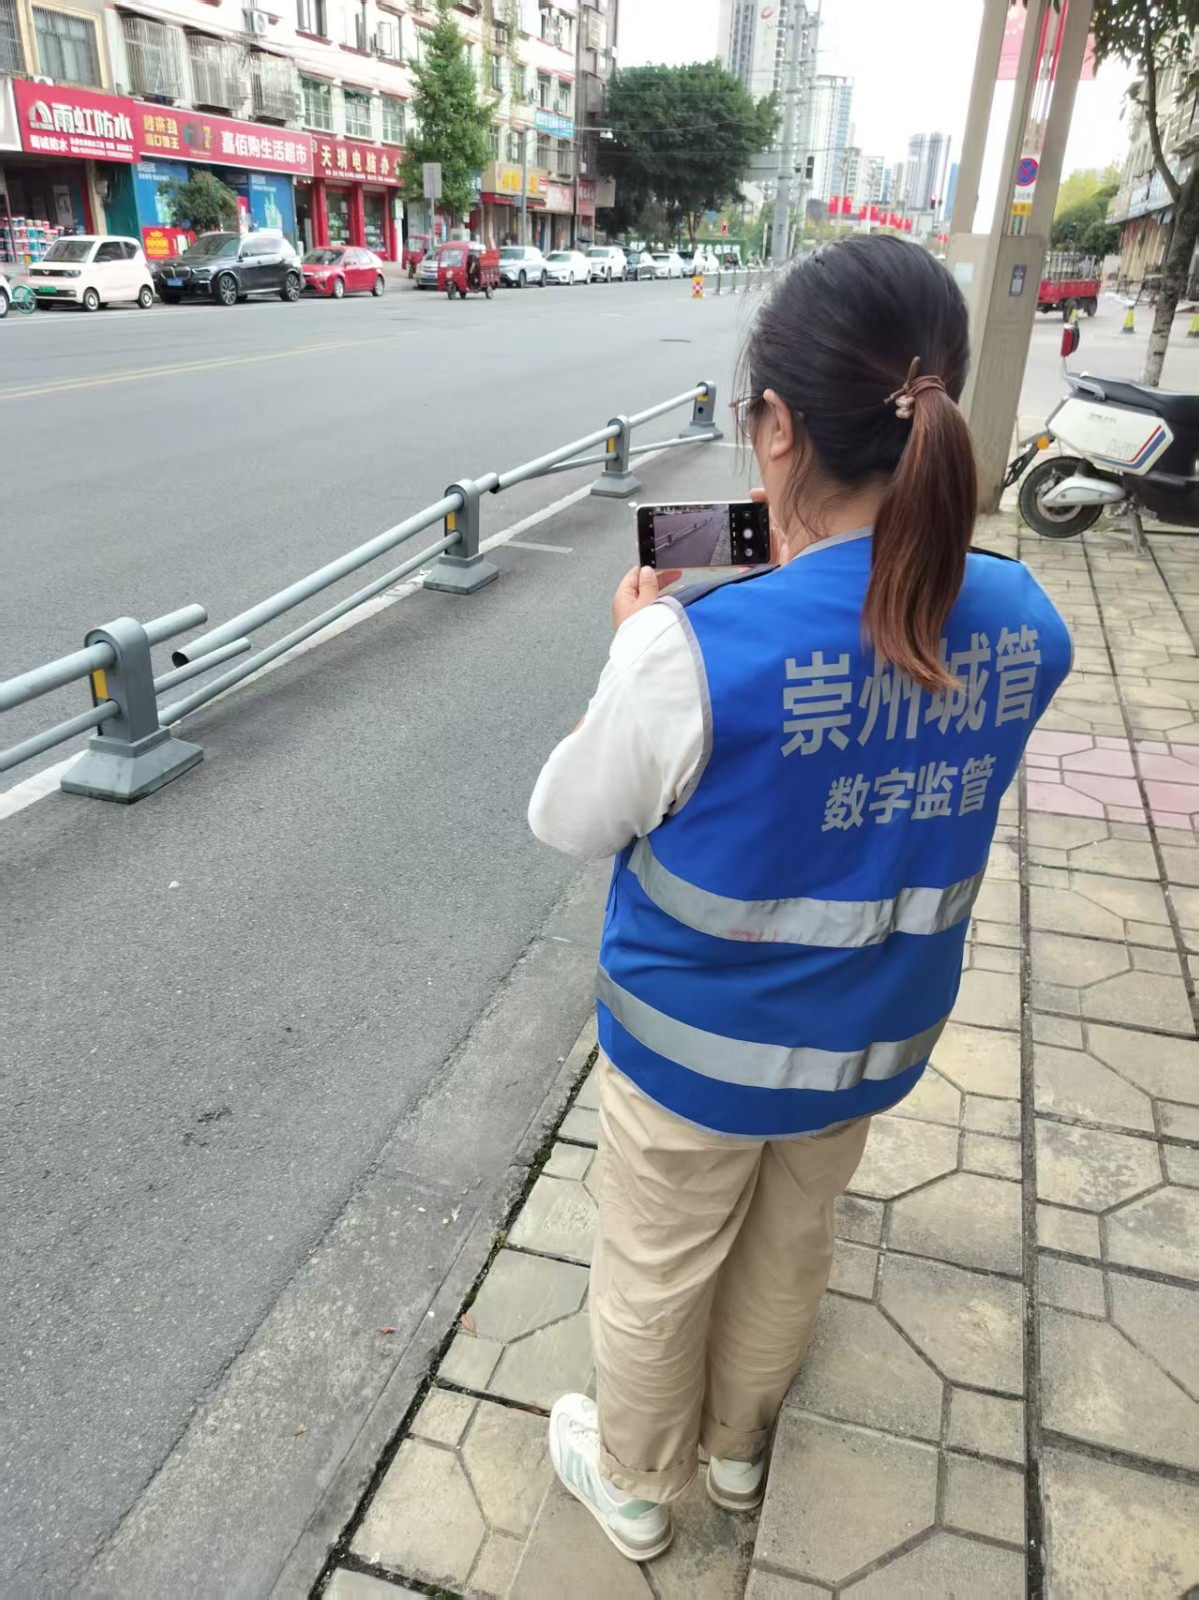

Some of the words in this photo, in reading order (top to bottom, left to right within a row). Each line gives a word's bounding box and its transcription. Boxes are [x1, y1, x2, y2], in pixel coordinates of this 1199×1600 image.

[51, 102, 134, 140] 雨虹防水
[221, 130, 307, 165] 嘉佰购生活超市
[780, 624, 1042, 758] 崇州城管
[821, 754, 997, 832] 数字监管
